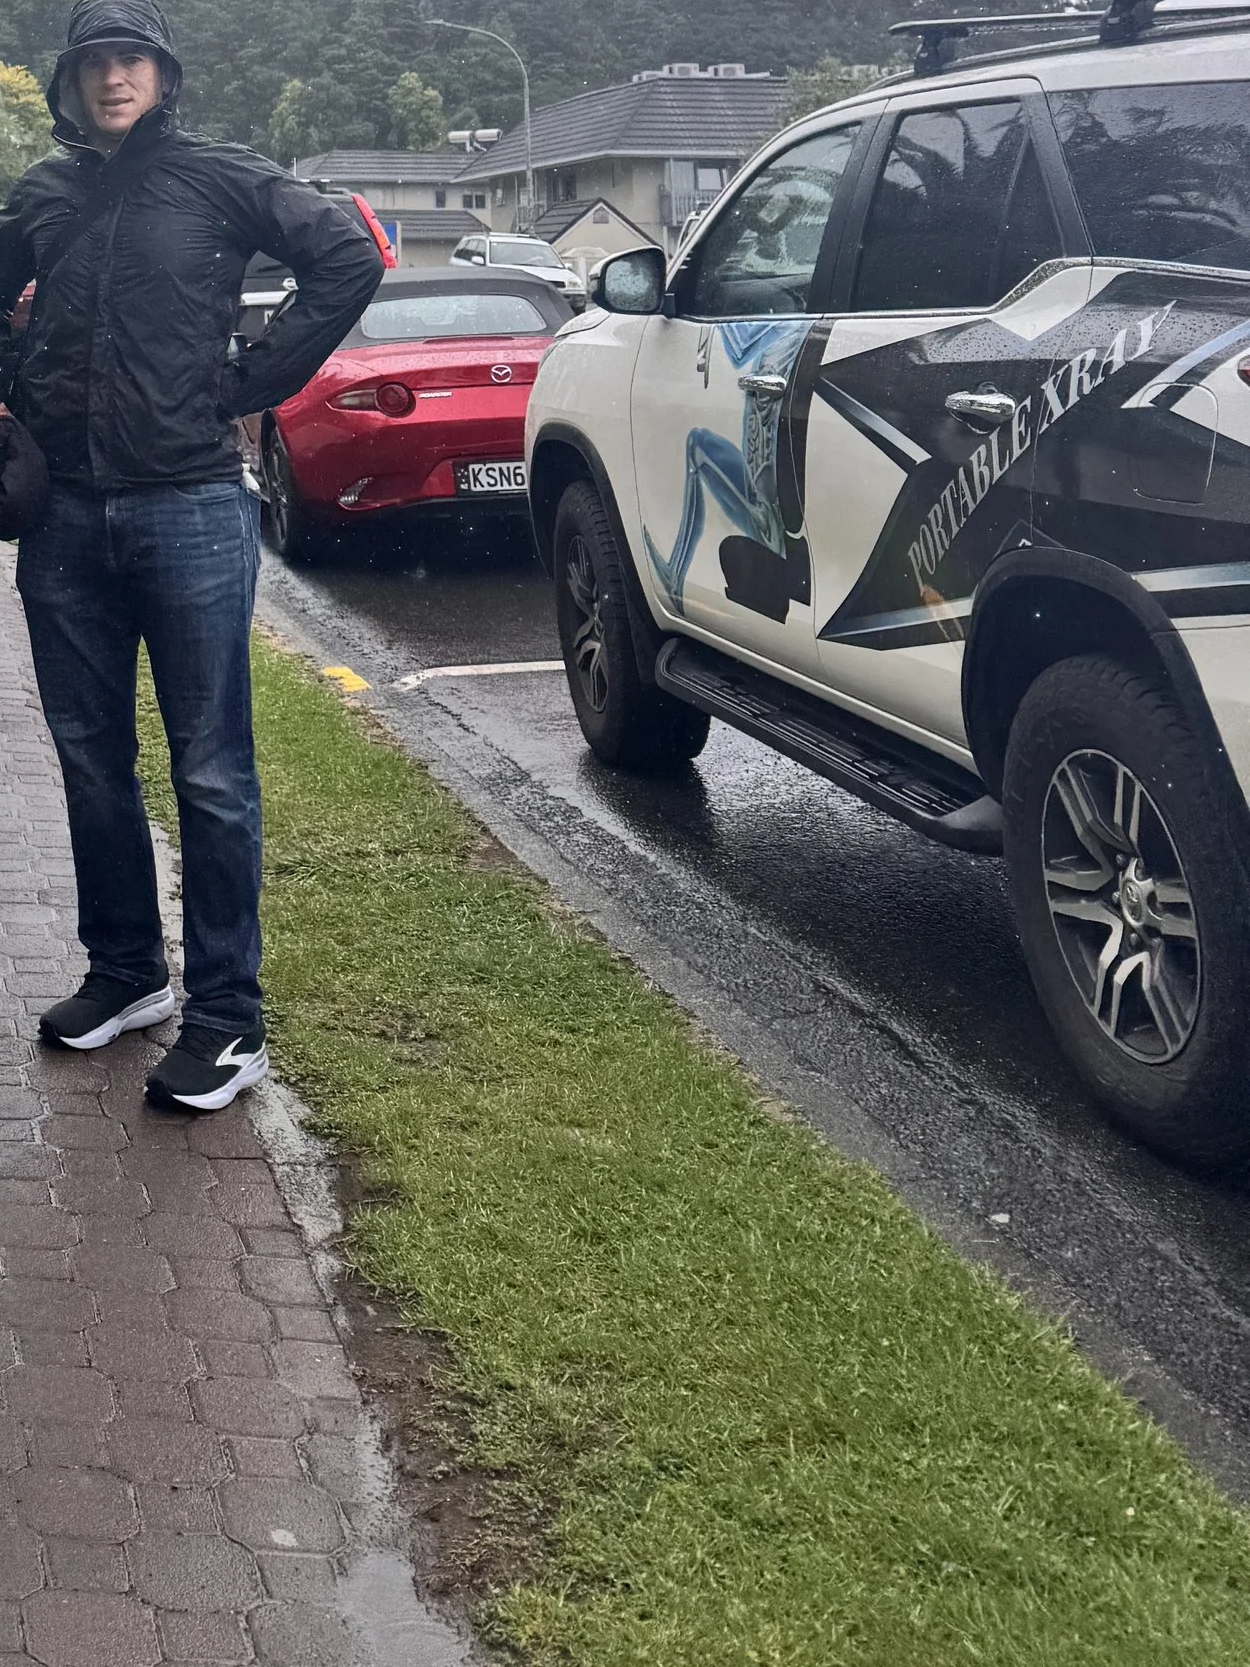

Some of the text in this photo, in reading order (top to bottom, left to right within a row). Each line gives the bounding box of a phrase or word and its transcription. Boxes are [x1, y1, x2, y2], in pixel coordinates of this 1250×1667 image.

[471, 466, 526, 488] KSN6
[907, 299, 1177, 592] PORTABLE XRAY
